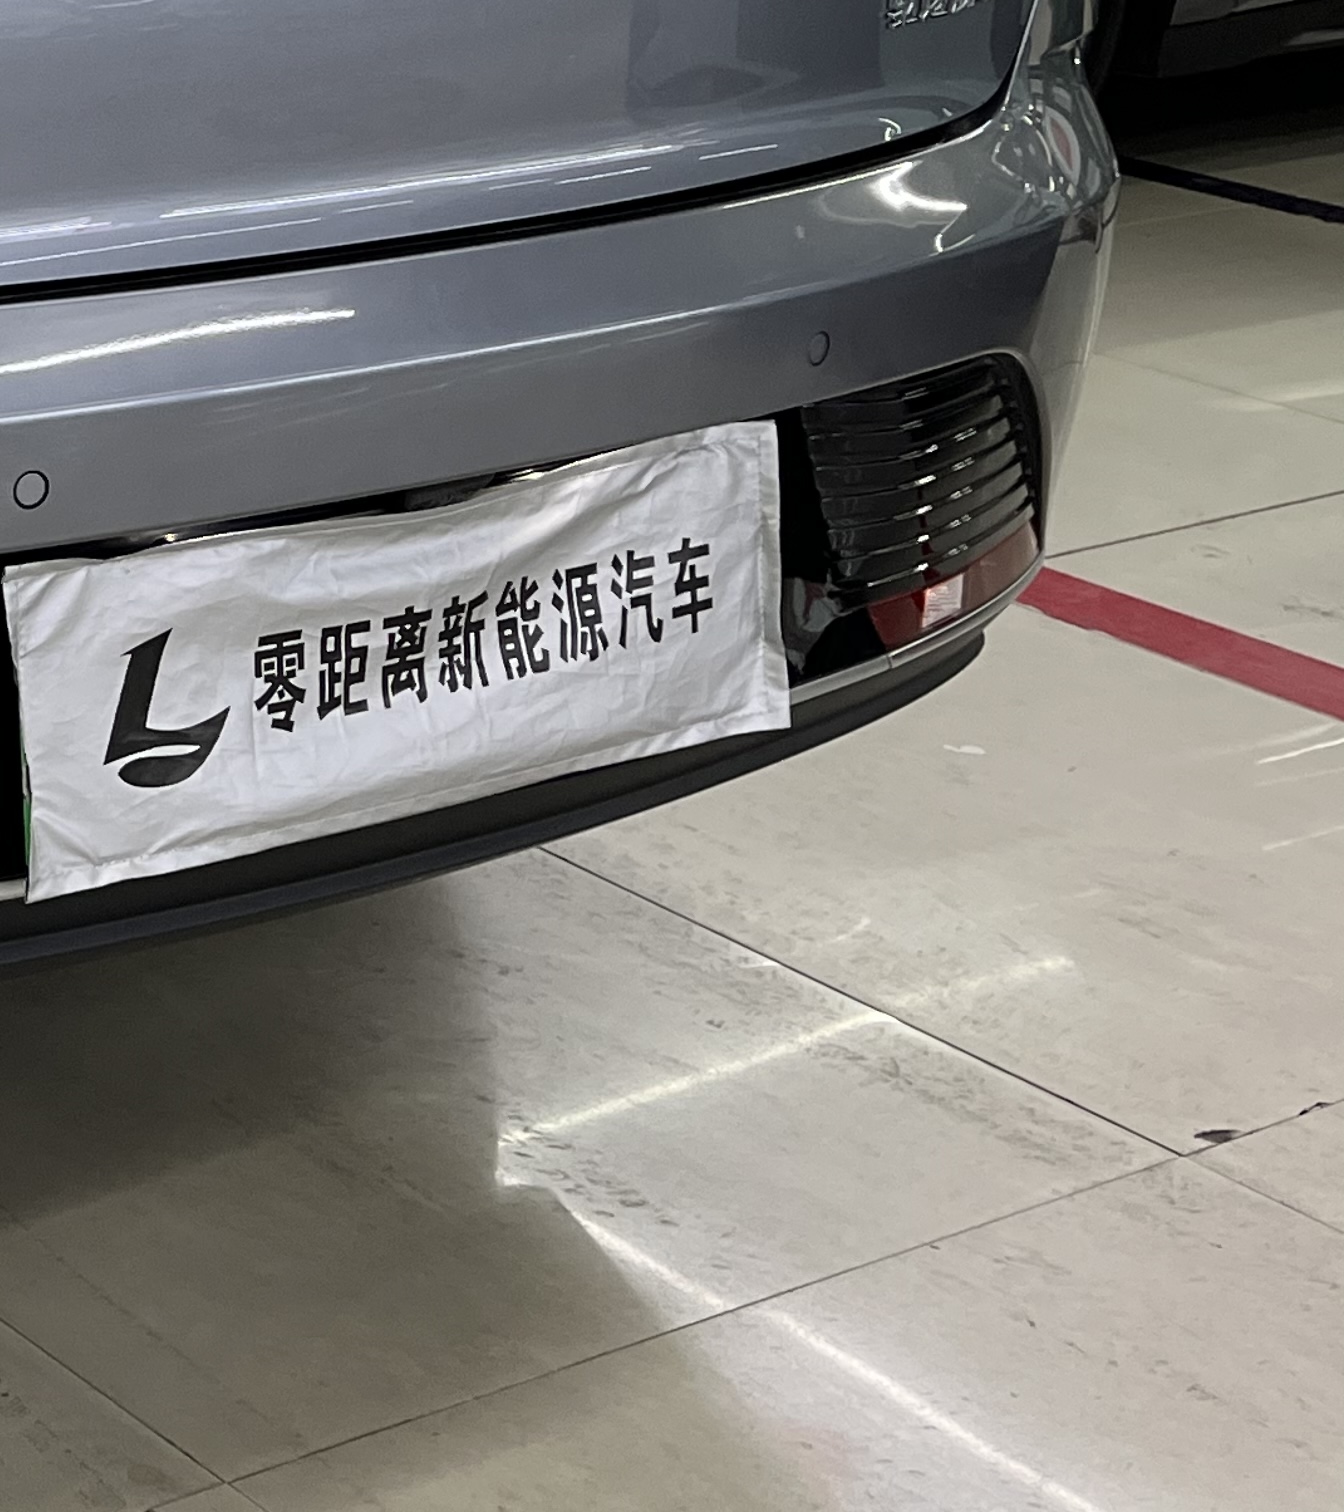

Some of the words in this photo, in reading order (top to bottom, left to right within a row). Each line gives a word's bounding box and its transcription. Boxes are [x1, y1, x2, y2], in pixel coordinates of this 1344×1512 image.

[251, 537, 714, 733] 零距离新能源汽车
